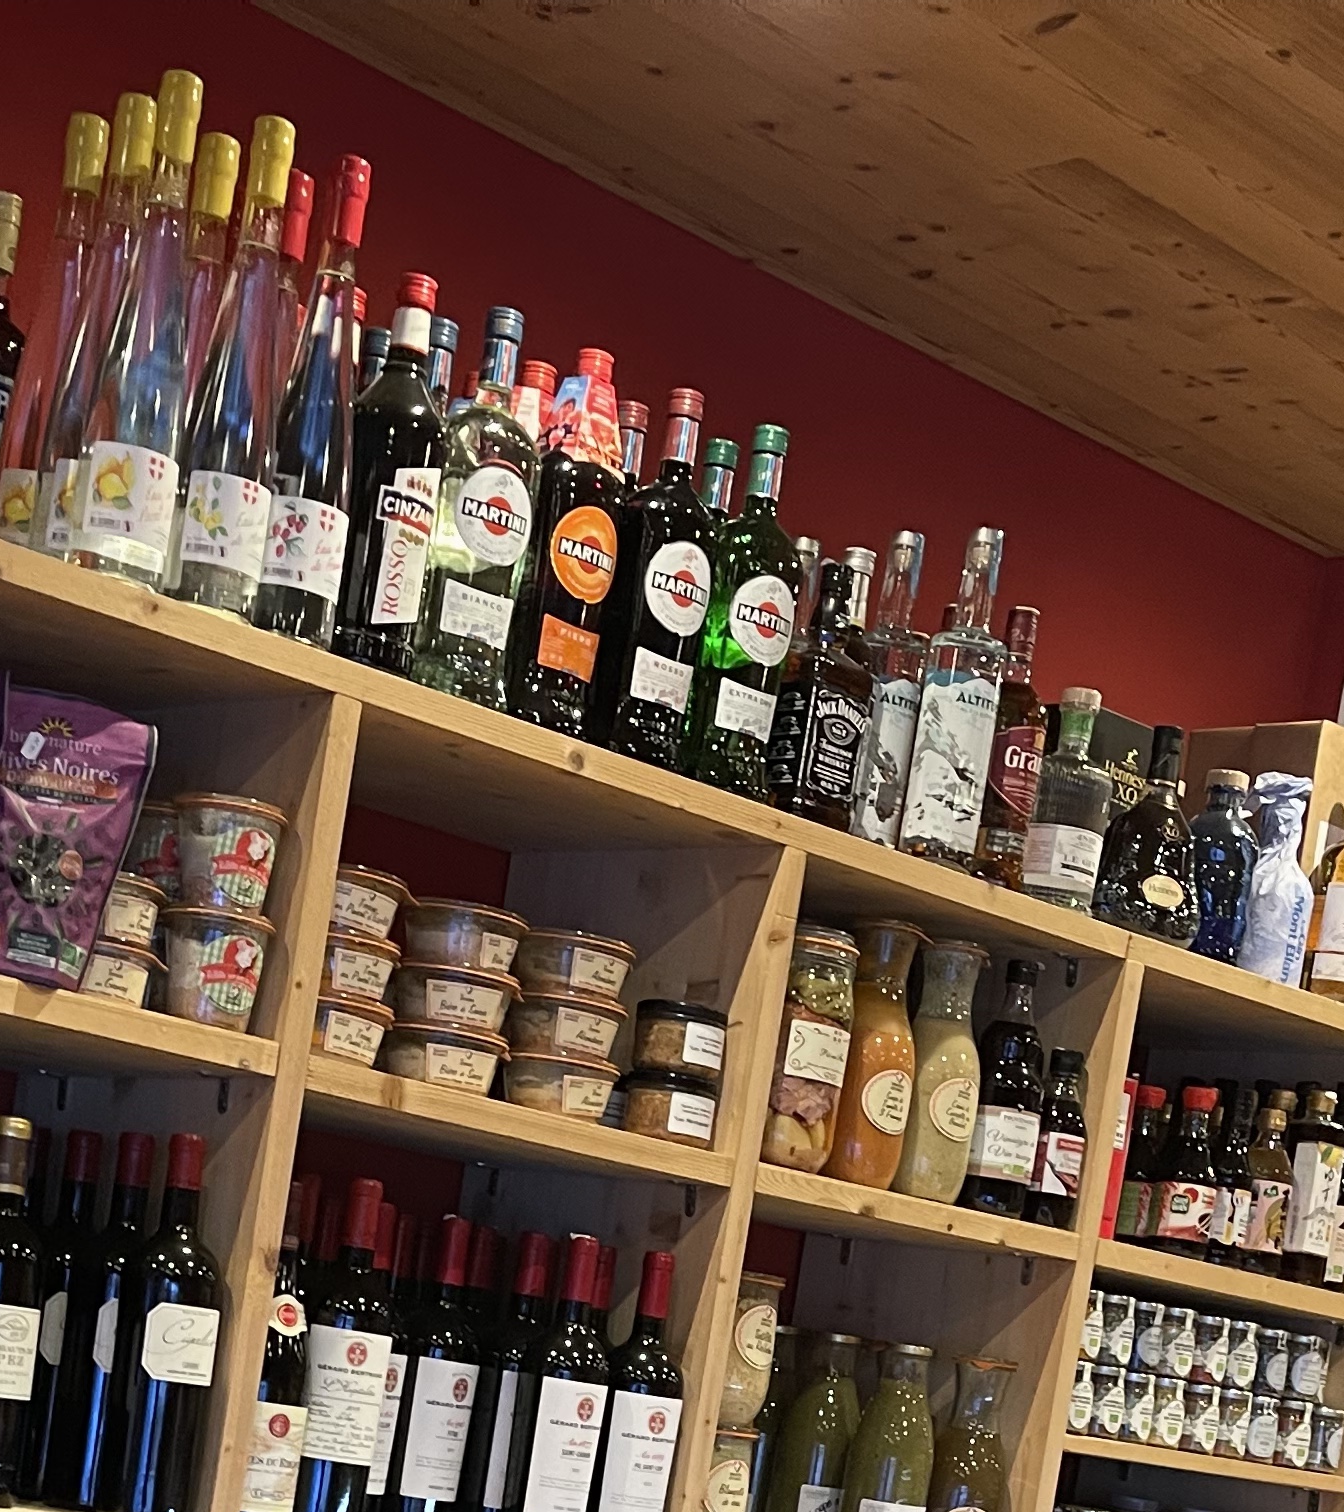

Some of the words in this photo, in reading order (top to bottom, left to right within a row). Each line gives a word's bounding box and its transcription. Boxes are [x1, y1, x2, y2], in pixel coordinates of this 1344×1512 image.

[464, 499, 528, 534] MARTINI
[560, 538, 614, 573] MARTINI
[381, 538, 407, 617] ROSSO
[652, 573, 707, 604] MARTINI
[461, 591, 504, 613] BIANCO
[738, 605, 792, 636] MARTINI
[816, 699, 839, 720] JACK
[53, 756, 120, 786] Noires
[1116, 781, 1138, 805] XO
[1287, 895, 1306, 942] Mont
